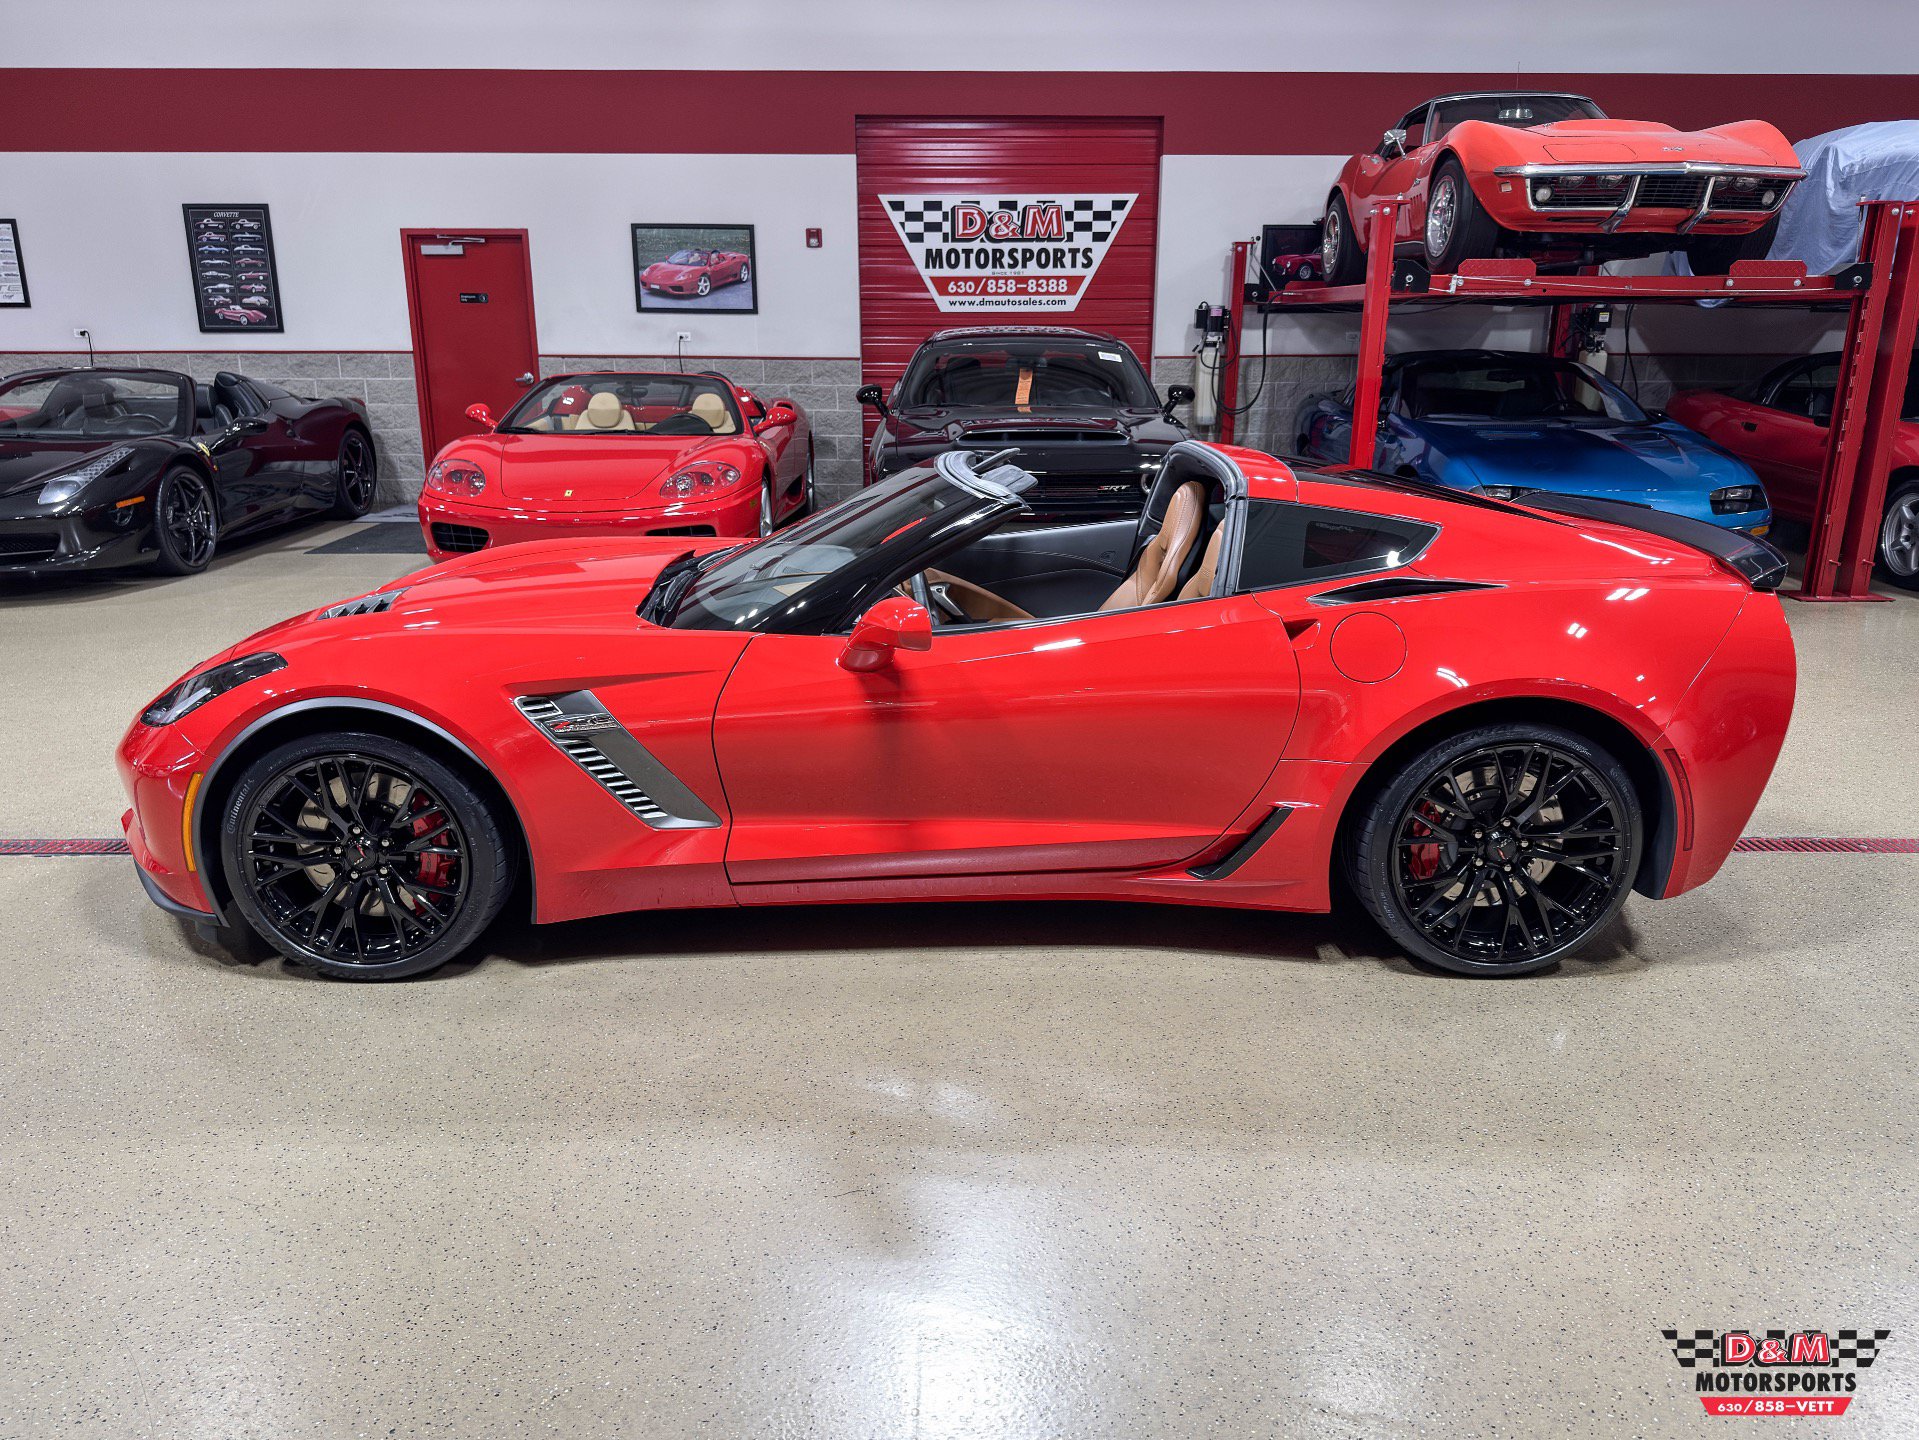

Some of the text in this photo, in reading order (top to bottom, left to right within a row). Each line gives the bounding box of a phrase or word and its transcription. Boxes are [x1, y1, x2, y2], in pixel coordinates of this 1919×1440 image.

[952, 205, 1065, 243] D&M
[924, 247, 1094, 270] MOTORSPORTS
[947, 278, 1068, 295] 630/858-8388
[948, 297, 1067, 307] www.dmautosales.com
